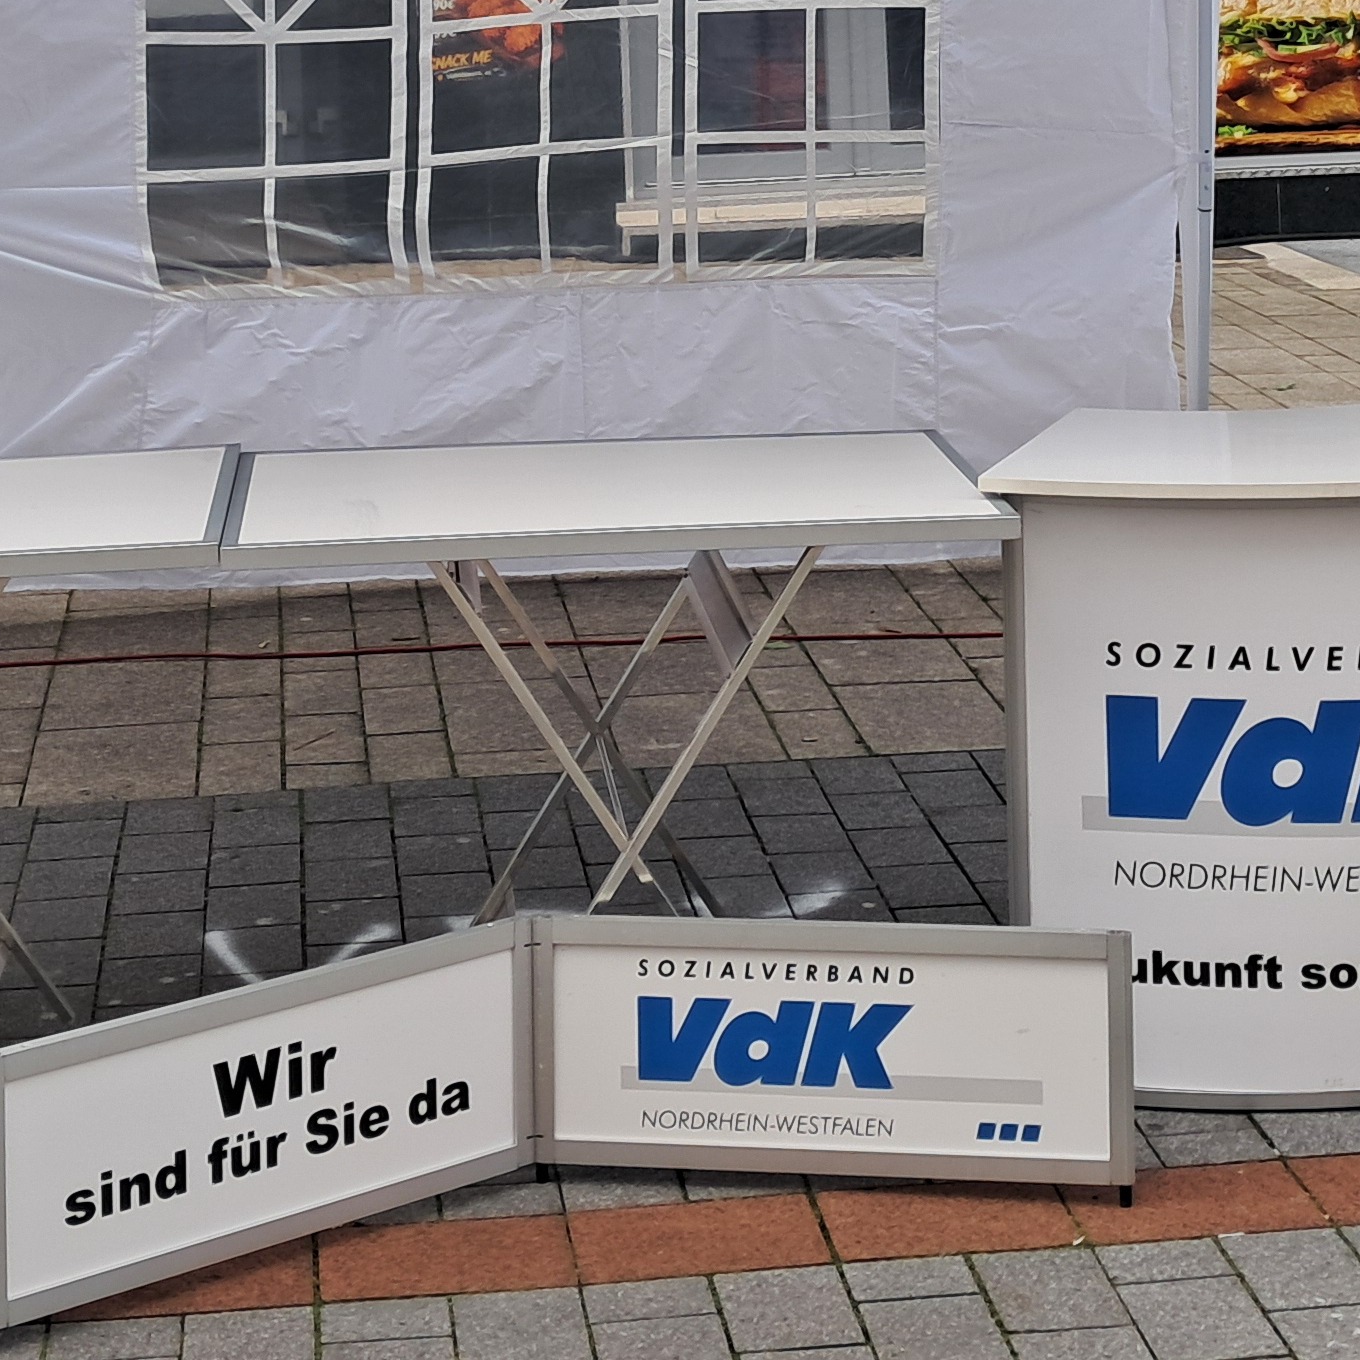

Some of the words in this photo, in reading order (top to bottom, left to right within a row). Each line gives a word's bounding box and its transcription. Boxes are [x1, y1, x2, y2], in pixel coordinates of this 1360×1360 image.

[638, 958, 915, 986] SOZIALVERBAND
[1131, 950, 1283, 990] ukunft
[637, 995, 915, 1089] VdK
[212, 1041, 337, 1119] Wir
[64, 1150, 187, 1226] sind
[207, 1130, 287, 1184] für
[305, 1102, 389, 1155] Sie
[408, 1078, 471, 1125] da
[641, 1110, 895, 1138] NORDRHEIN-WESTFALEN
